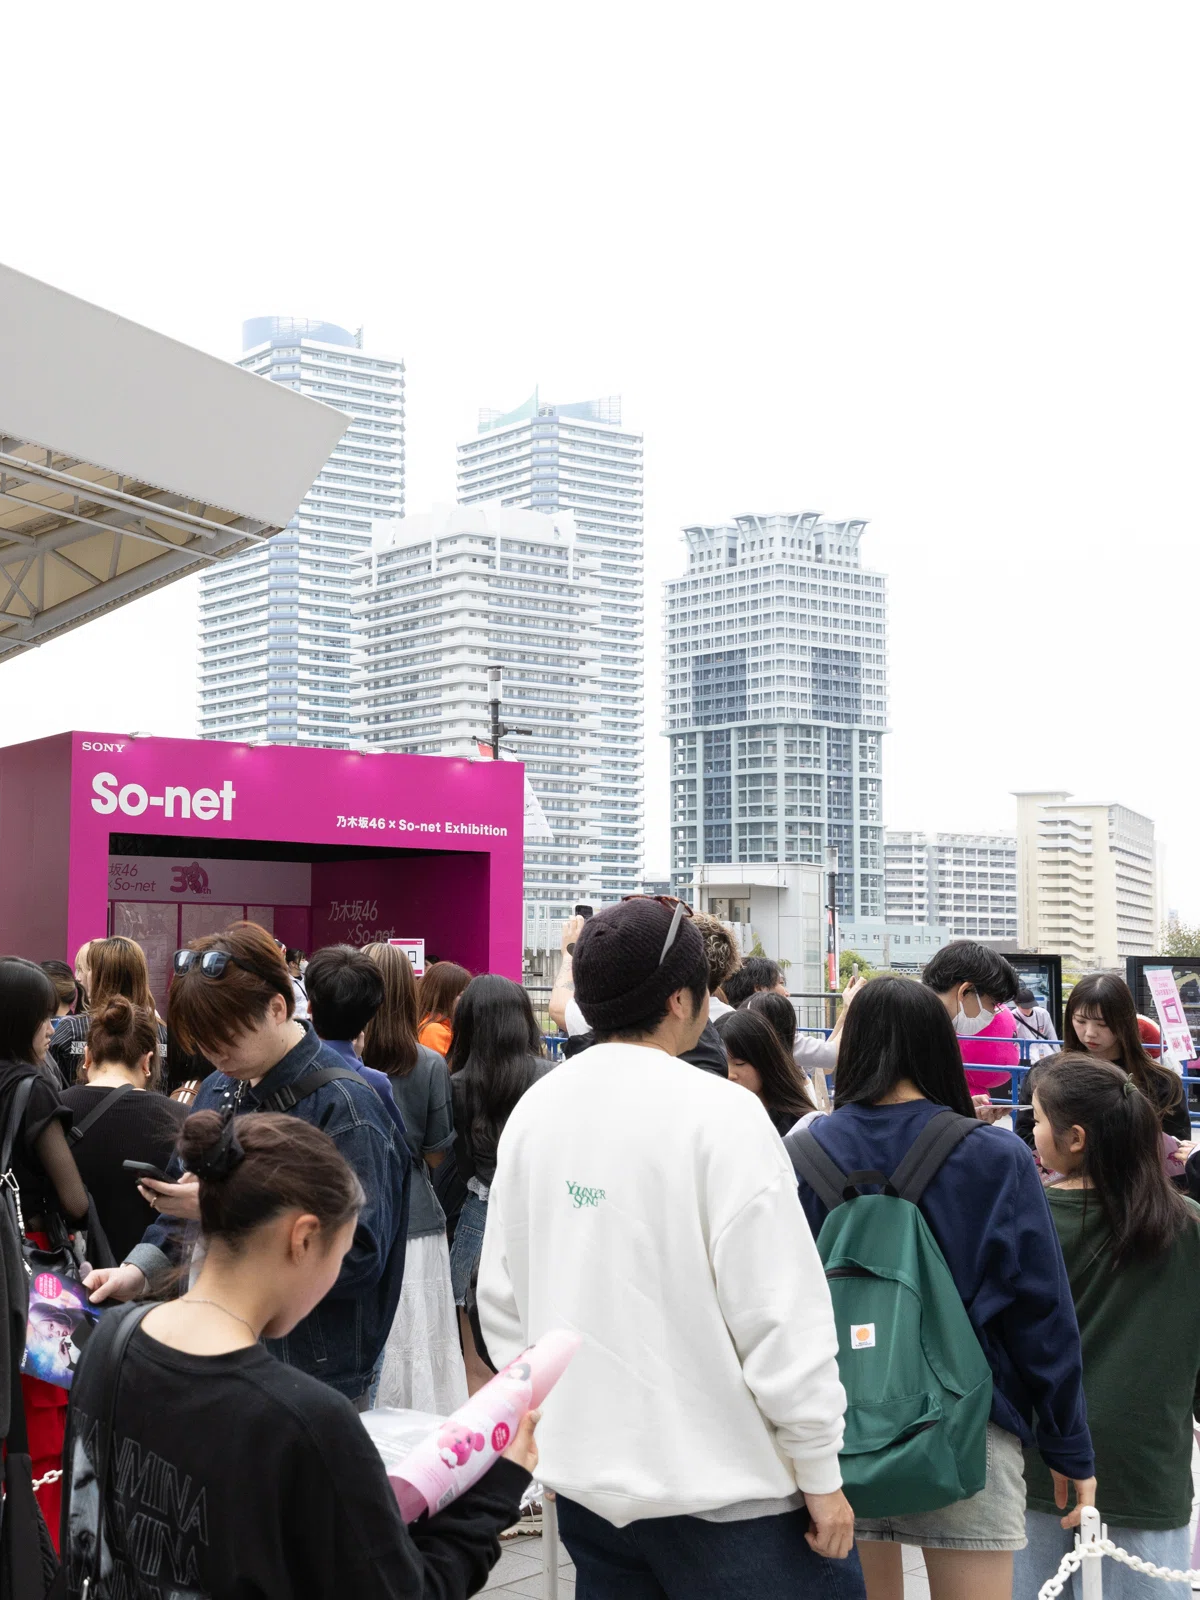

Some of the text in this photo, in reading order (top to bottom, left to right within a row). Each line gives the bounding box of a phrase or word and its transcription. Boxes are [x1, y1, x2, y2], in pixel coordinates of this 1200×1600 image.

[82, 741, 125, 753] SONY
[91, 771, 237, 821] So-net
[336, 815, 386, 830] 乃木坂46
[399, 820, 441, 833] So-net
[445, 822, 508, 837] Exhibition
[328, 899, 379, 922] 乃木坂46
